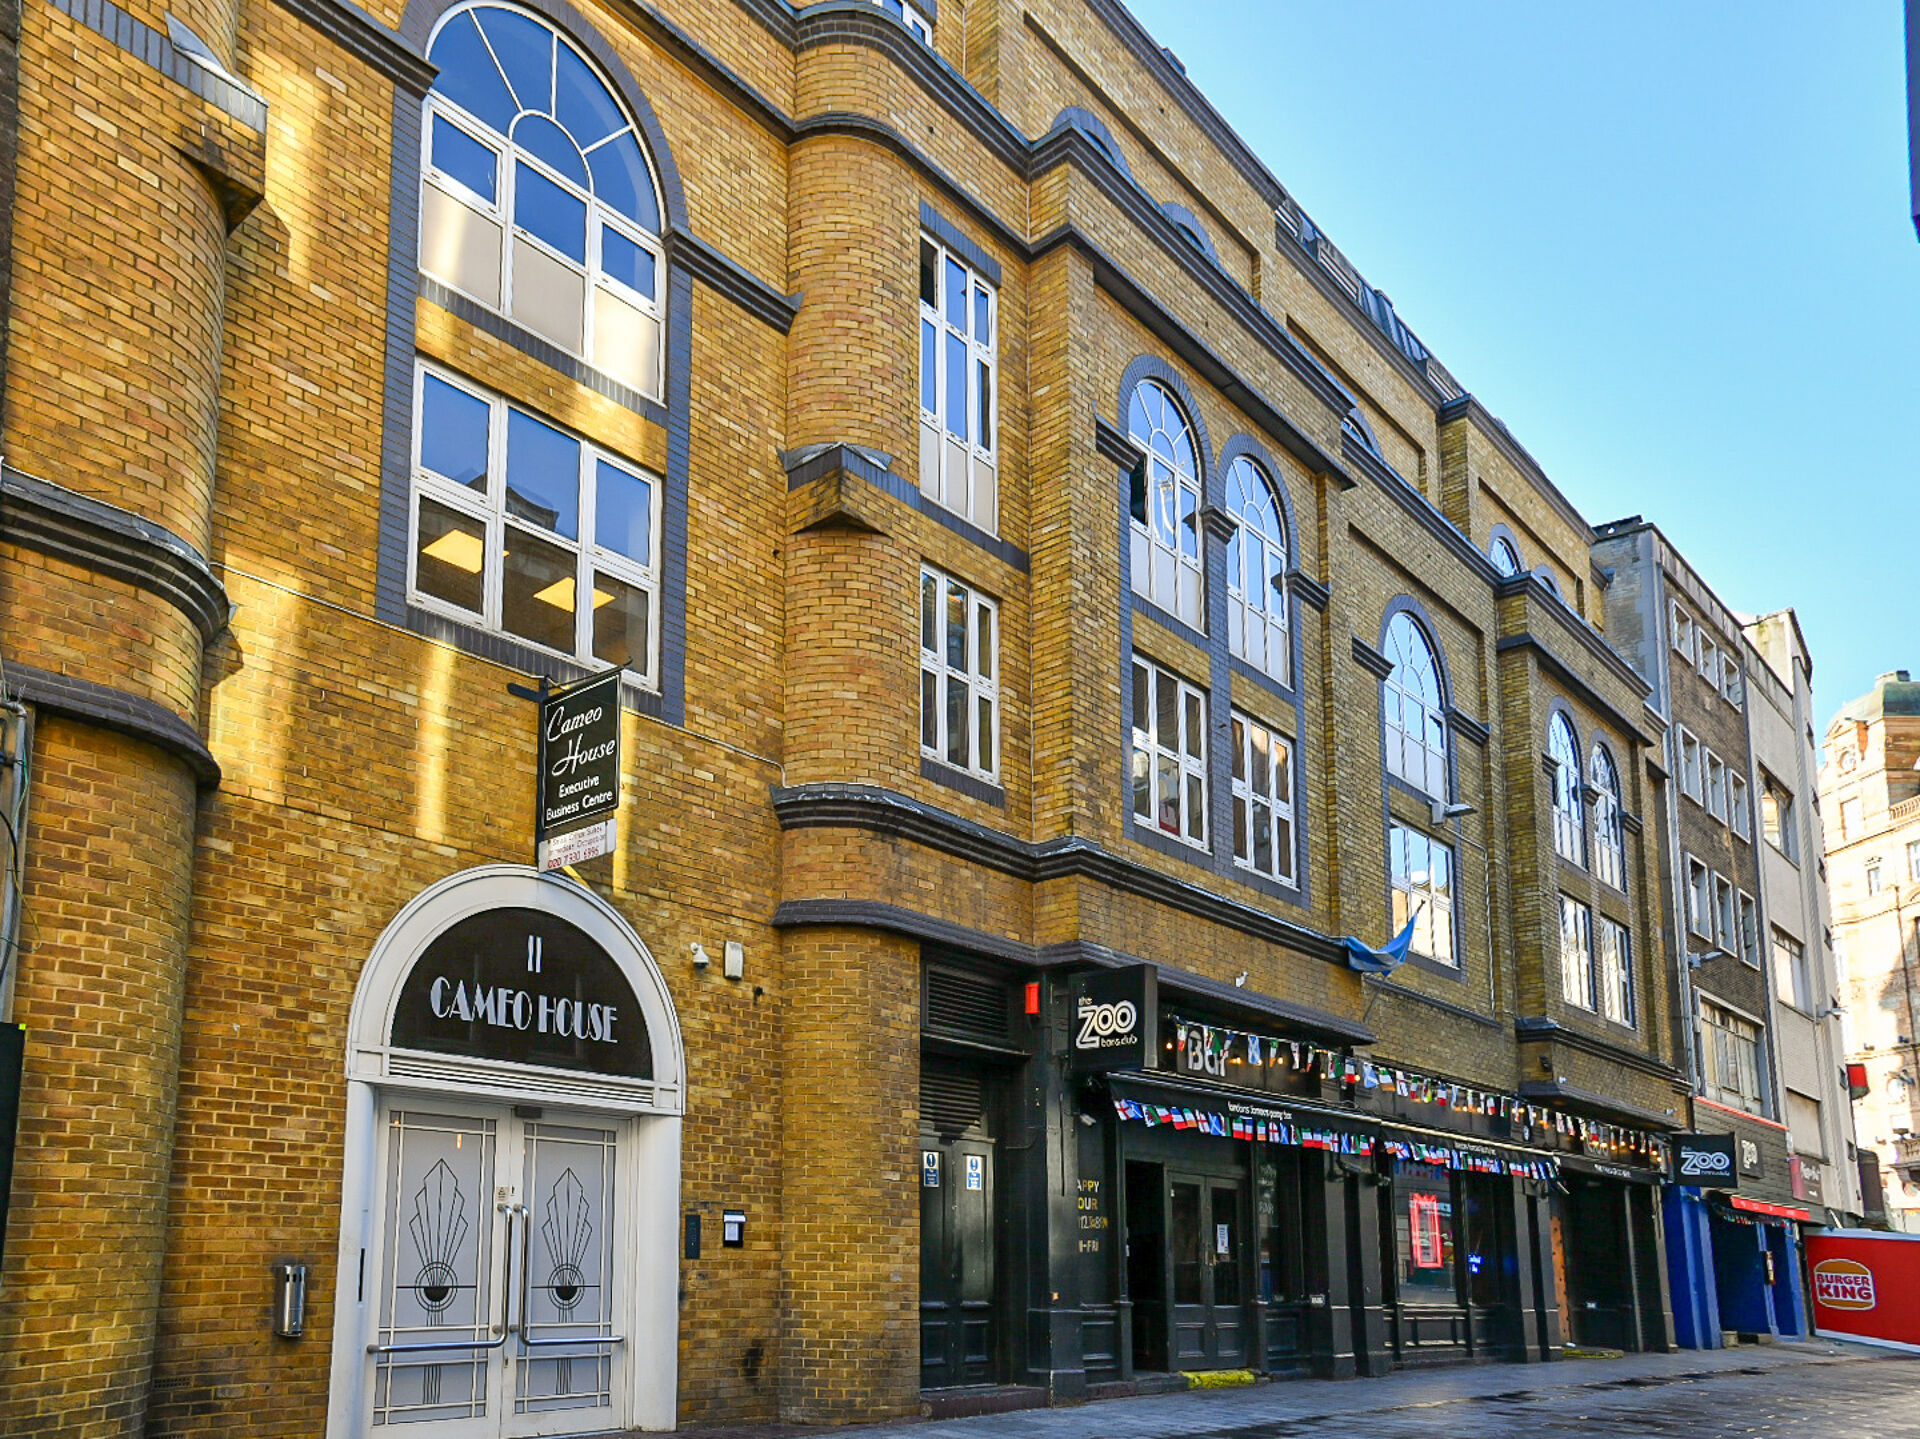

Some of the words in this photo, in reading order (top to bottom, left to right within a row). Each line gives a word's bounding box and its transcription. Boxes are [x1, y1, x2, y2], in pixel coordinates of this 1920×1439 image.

[547, 706, 602, 741] Cameo
[552, 733, 616, 776] House
[558, 775, 600, 798] Executive
[546, 801, 580, 821] Business
[582, 790, 613, 808] Centre
[430, 976, 533, 1031] CAMEO
[538, 994, 619, 1043] HOUSE
[1078, 997, 1093, 1006] the
[1075, 1000, 1137, 1049] ZOO
[1680, 1151, 1730, 1175] ZOO
[1077, 1178, 1100, 1193] APPY
[1077, 1197, 1098, 1211] OUR
[1816, 1273, 1870, 1286] BURGER
[1818, 1283, 1873, 1300] KING
